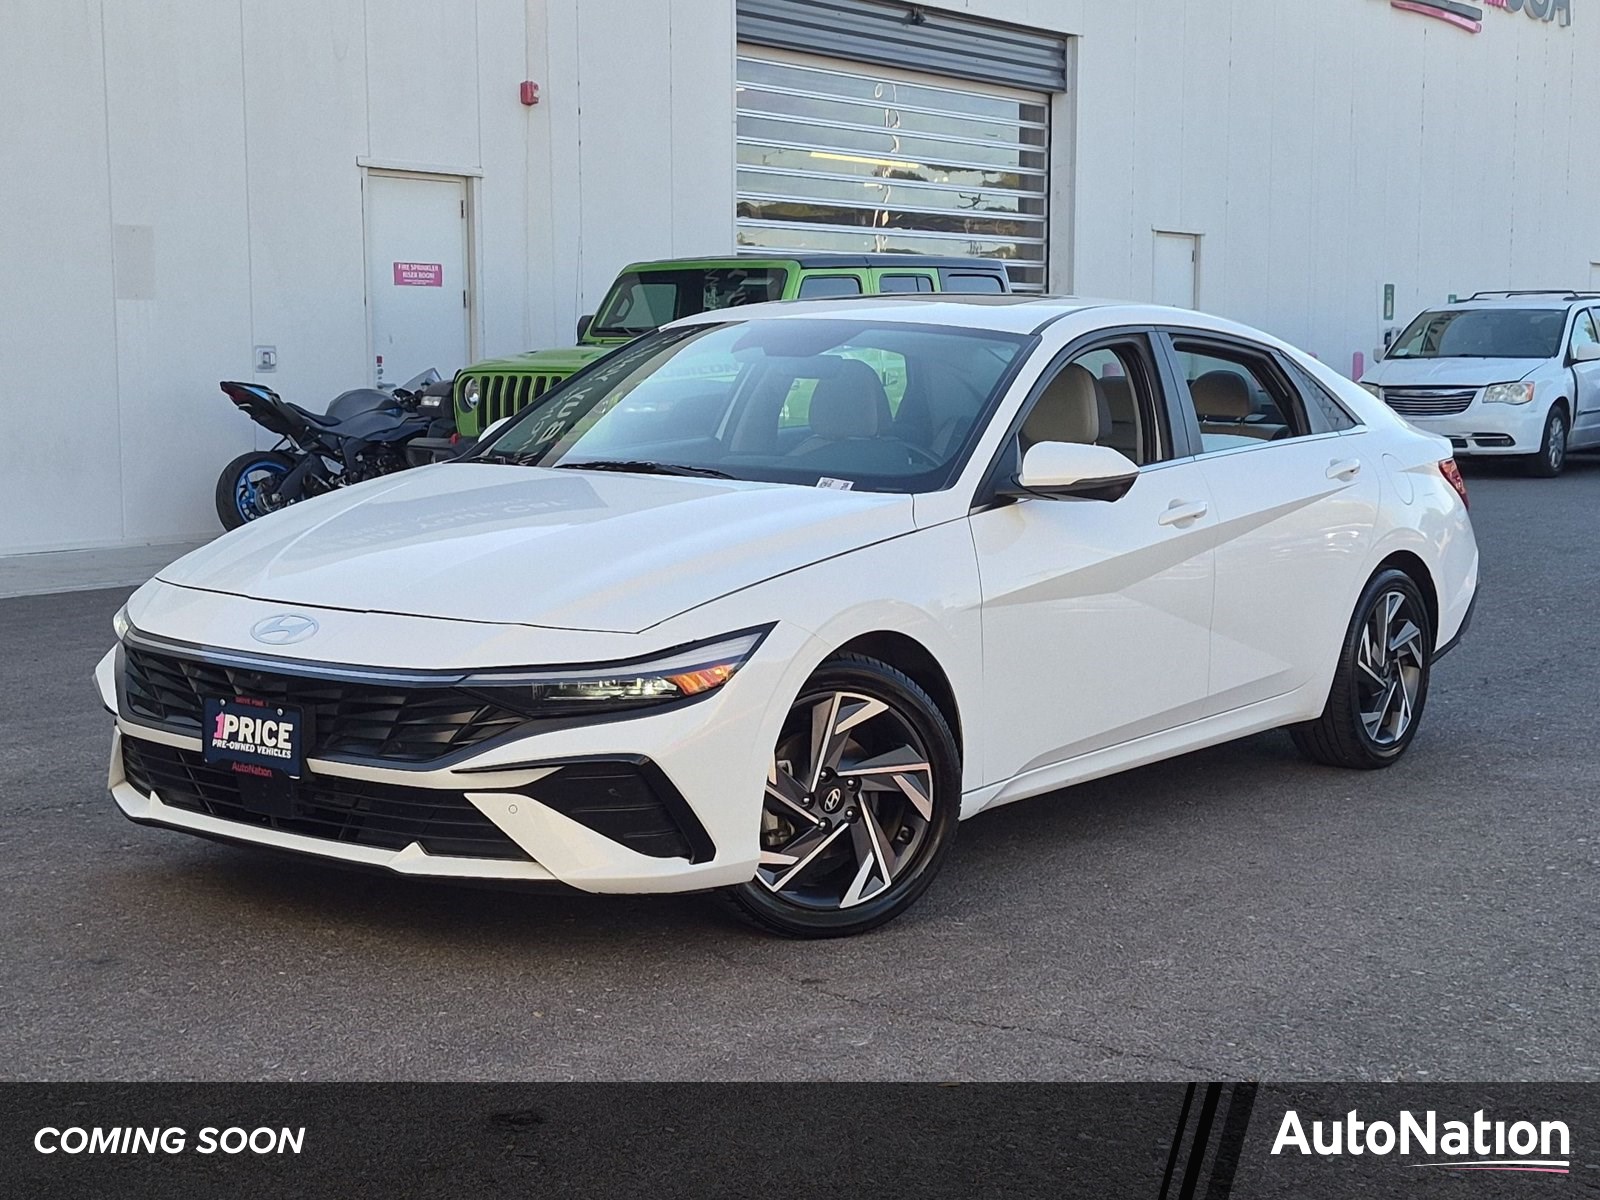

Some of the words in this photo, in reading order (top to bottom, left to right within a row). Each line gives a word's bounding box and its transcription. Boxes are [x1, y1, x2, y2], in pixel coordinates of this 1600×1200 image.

[211, 739, 256, 753] PRE-OWNED
[256, 745, 292, 759] VEHICLES
[231, 761, 273, 778] AutoNation
